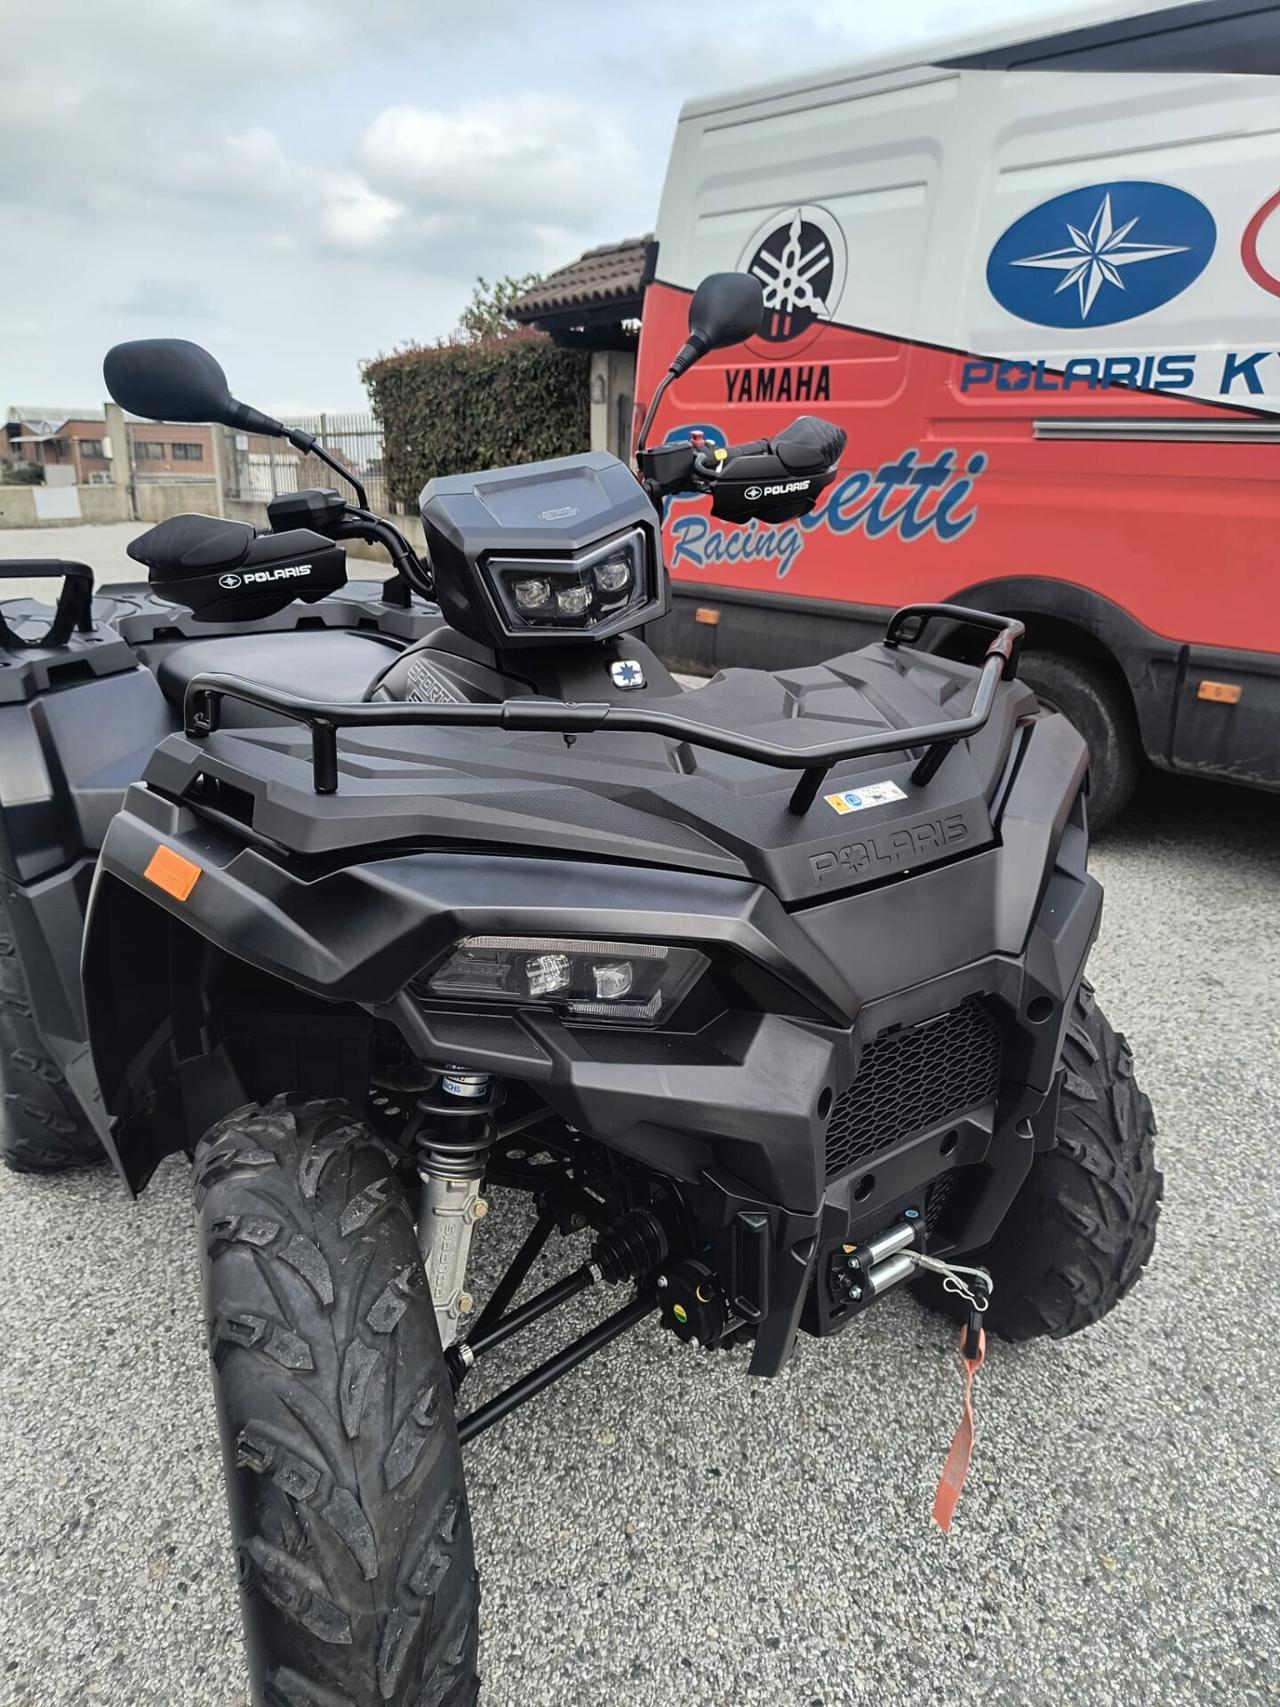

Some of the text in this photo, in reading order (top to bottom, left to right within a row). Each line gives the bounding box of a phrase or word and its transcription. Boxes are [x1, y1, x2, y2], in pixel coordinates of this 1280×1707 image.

[725, 366, 830, 402] YAMAHA
[960, 351, 1280, 394] POLARIS K
[764, 480, 811, 496] POLARIS
[671, 517, 803, 576] Racing
[243, 564, 312, 585] POLARIS
[407, 661, 458, 703] SPORT
[808, 815, 968, 888] POLARIS
